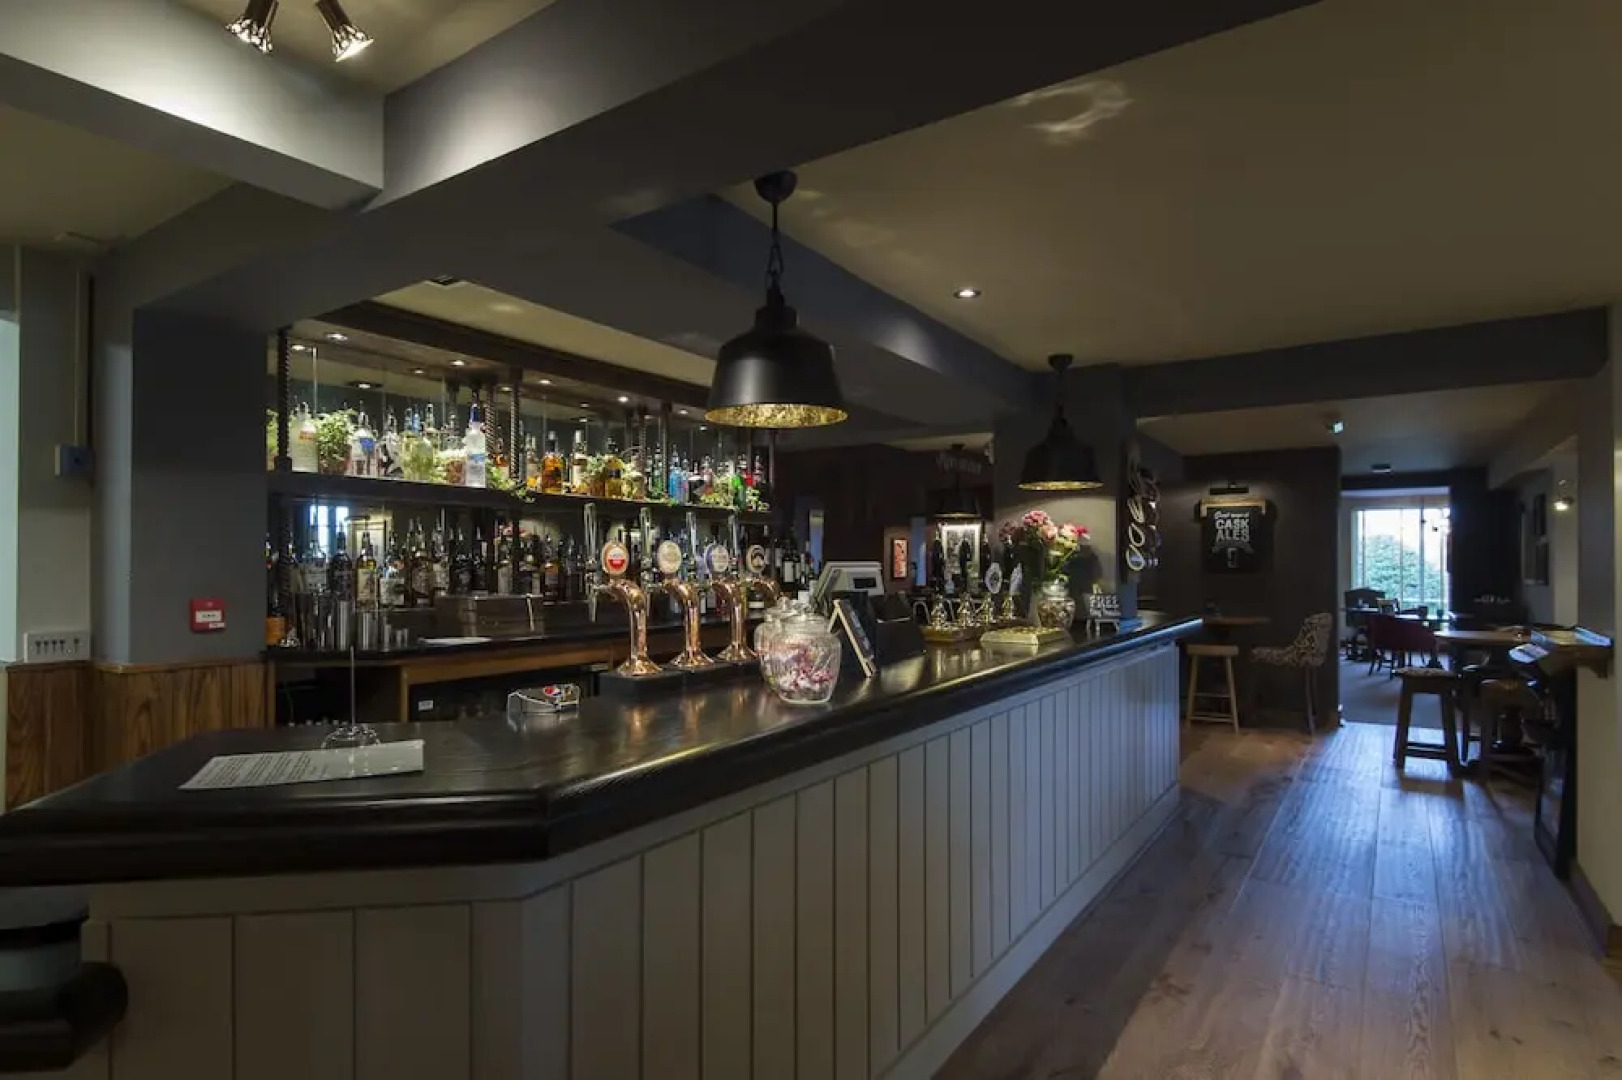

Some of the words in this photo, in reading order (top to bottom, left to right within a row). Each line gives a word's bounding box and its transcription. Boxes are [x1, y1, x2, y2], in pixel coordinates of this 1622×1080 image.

[1215, 518, 1250, 530] CASK
[1216, 529, 1250, 543] ALES
[1089, 595, 1120, 608] FREE
